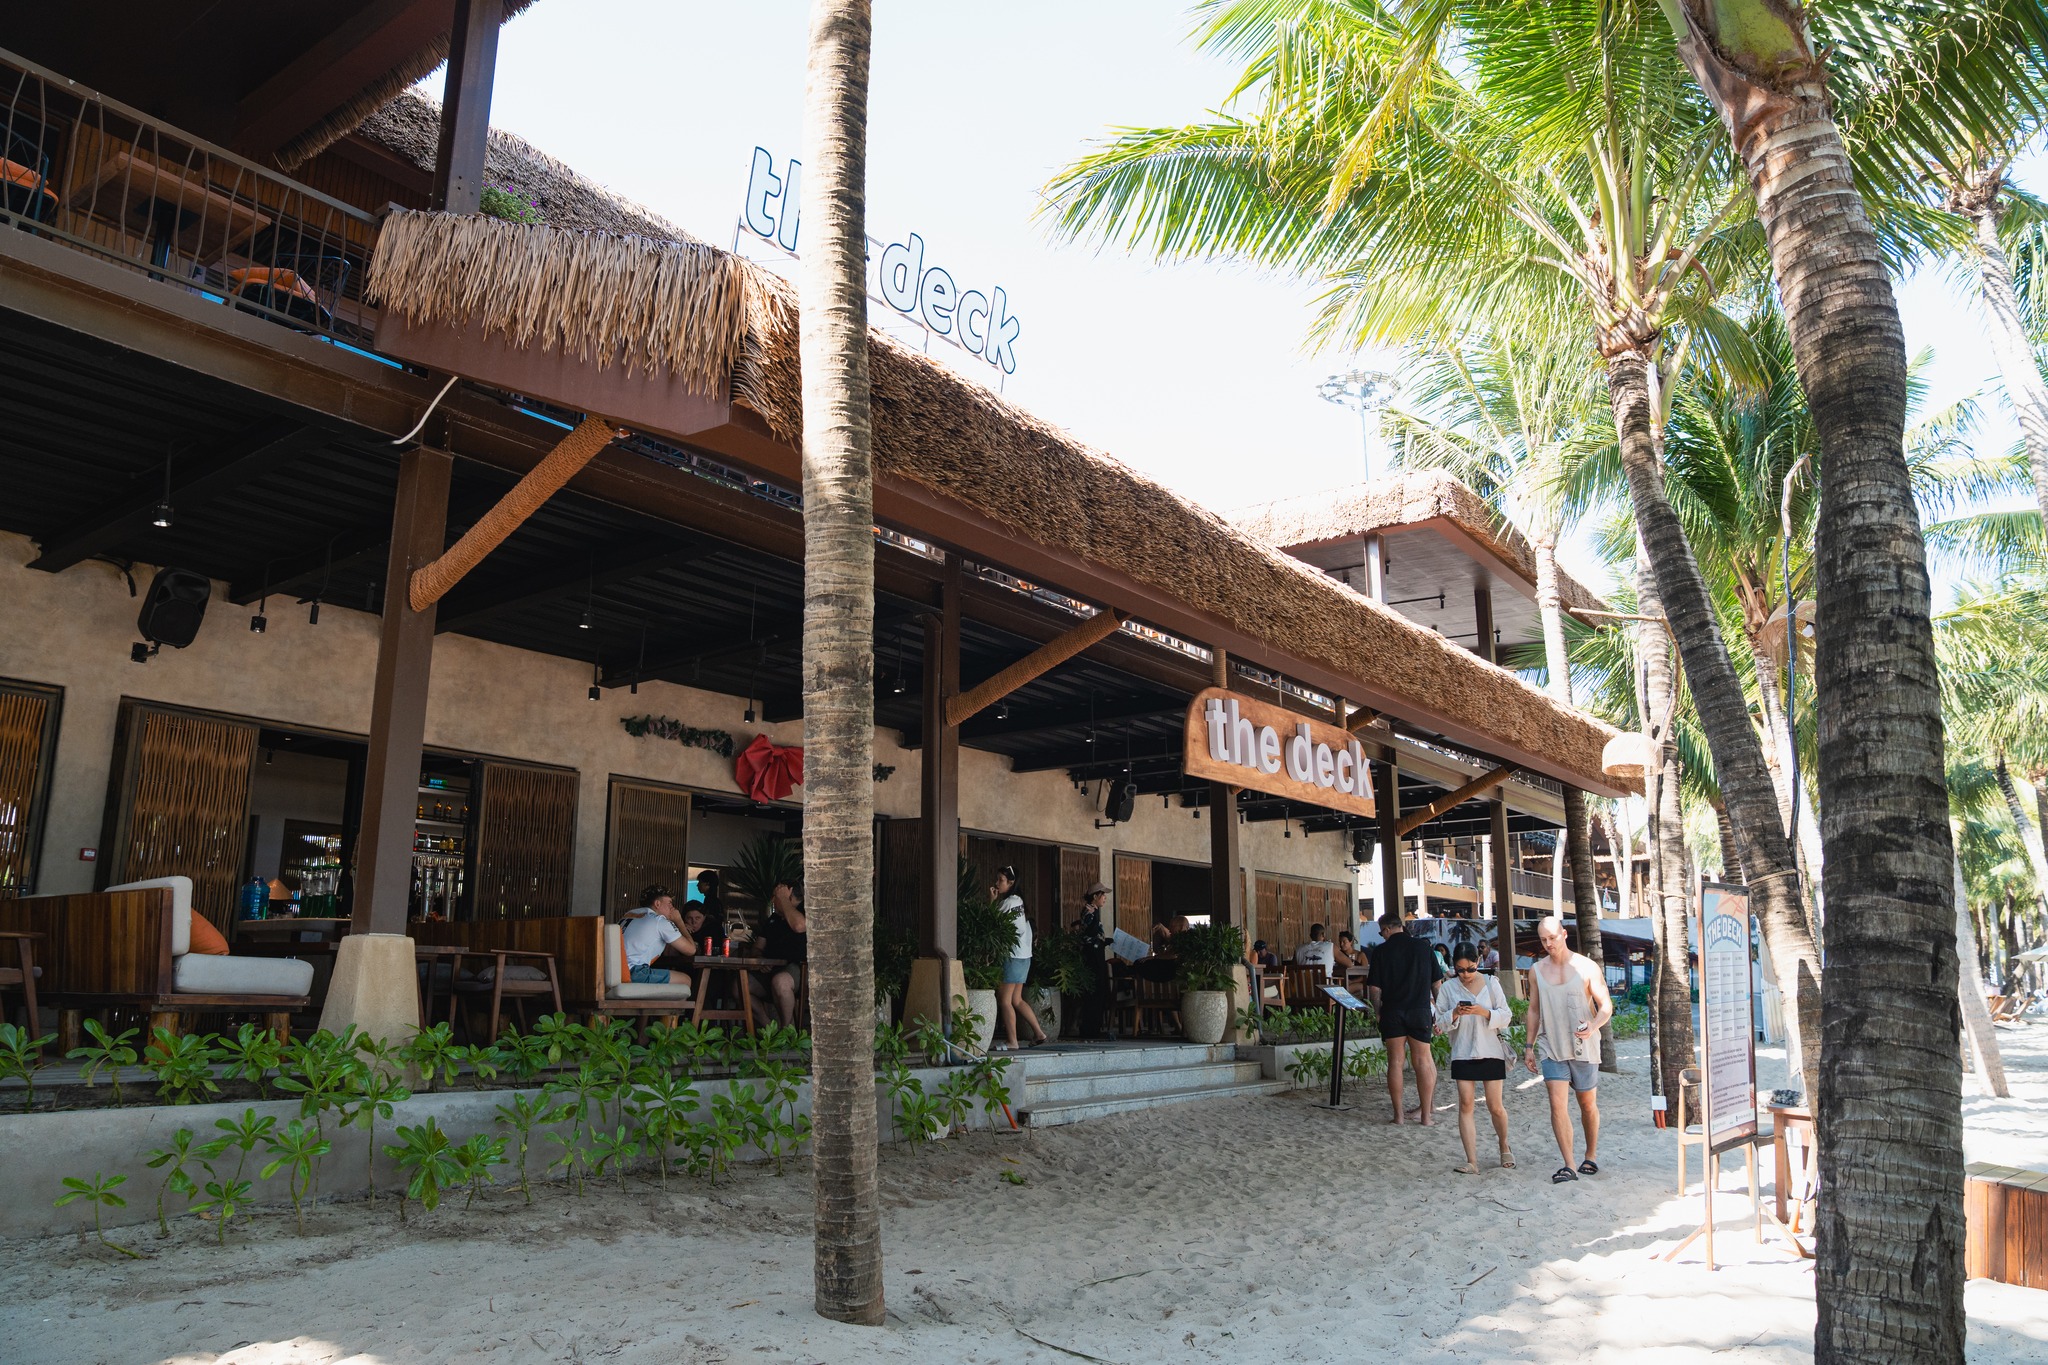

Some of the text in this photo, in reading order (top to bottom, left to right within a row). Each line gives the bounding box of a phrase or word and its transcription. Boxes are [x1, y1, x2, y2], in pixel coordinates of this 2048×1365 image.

[880, 232, 1020, 374] deck
[1205, 698, 1374, 799] the deck
[1707, 915, 1742, 948] THE DECK
